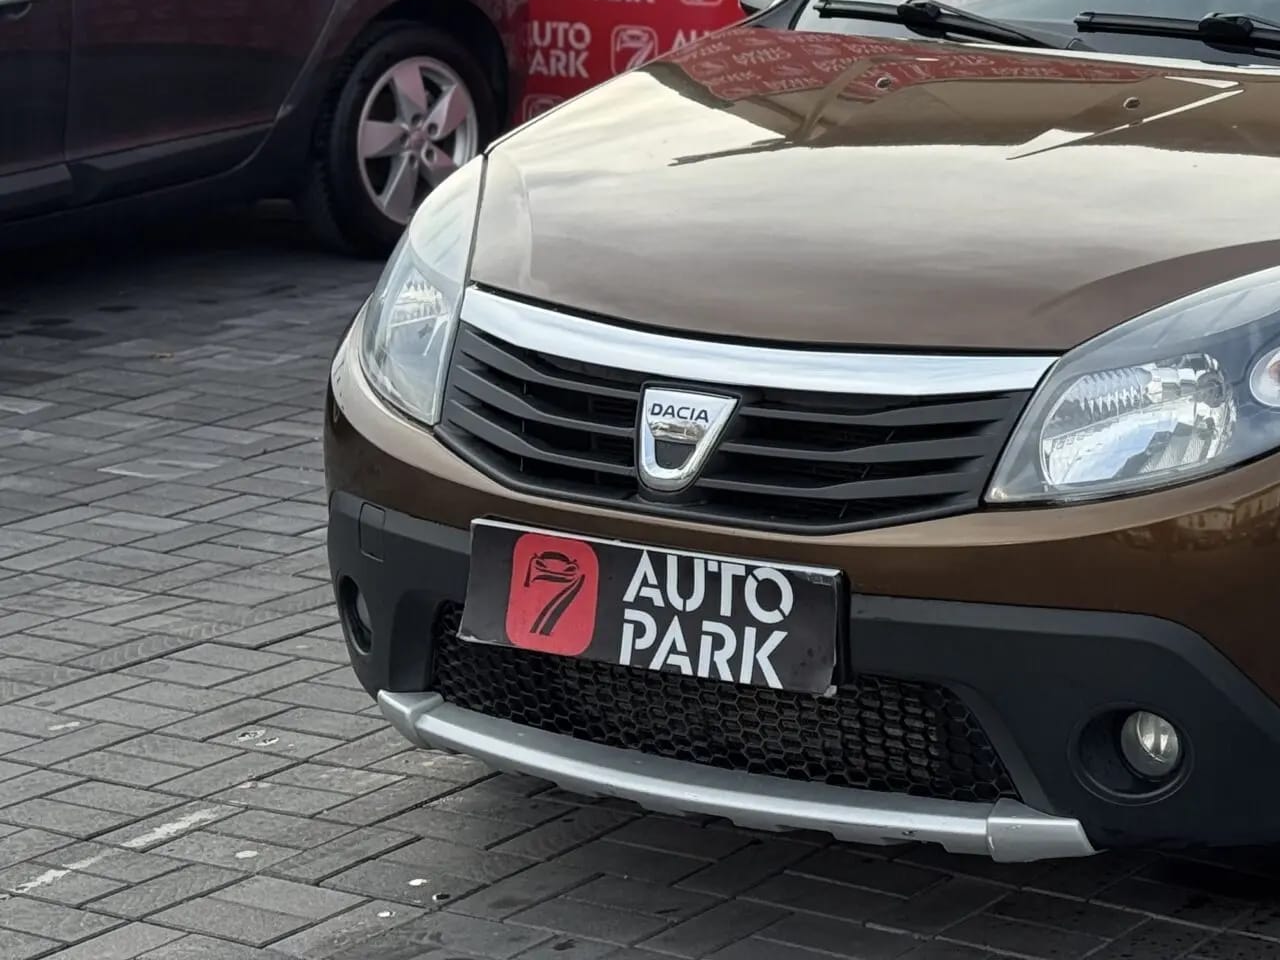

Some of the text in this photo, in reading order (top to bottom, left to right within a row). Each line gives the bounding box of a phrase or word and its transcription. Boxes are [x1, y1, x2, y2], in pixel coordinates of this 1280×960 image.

[529, 21, 591, 50] UTO
[650, 403, 709, 423] DACIA
[622, 550, 794, 624] AUTO
[618, 609, 789, 689] PARK
